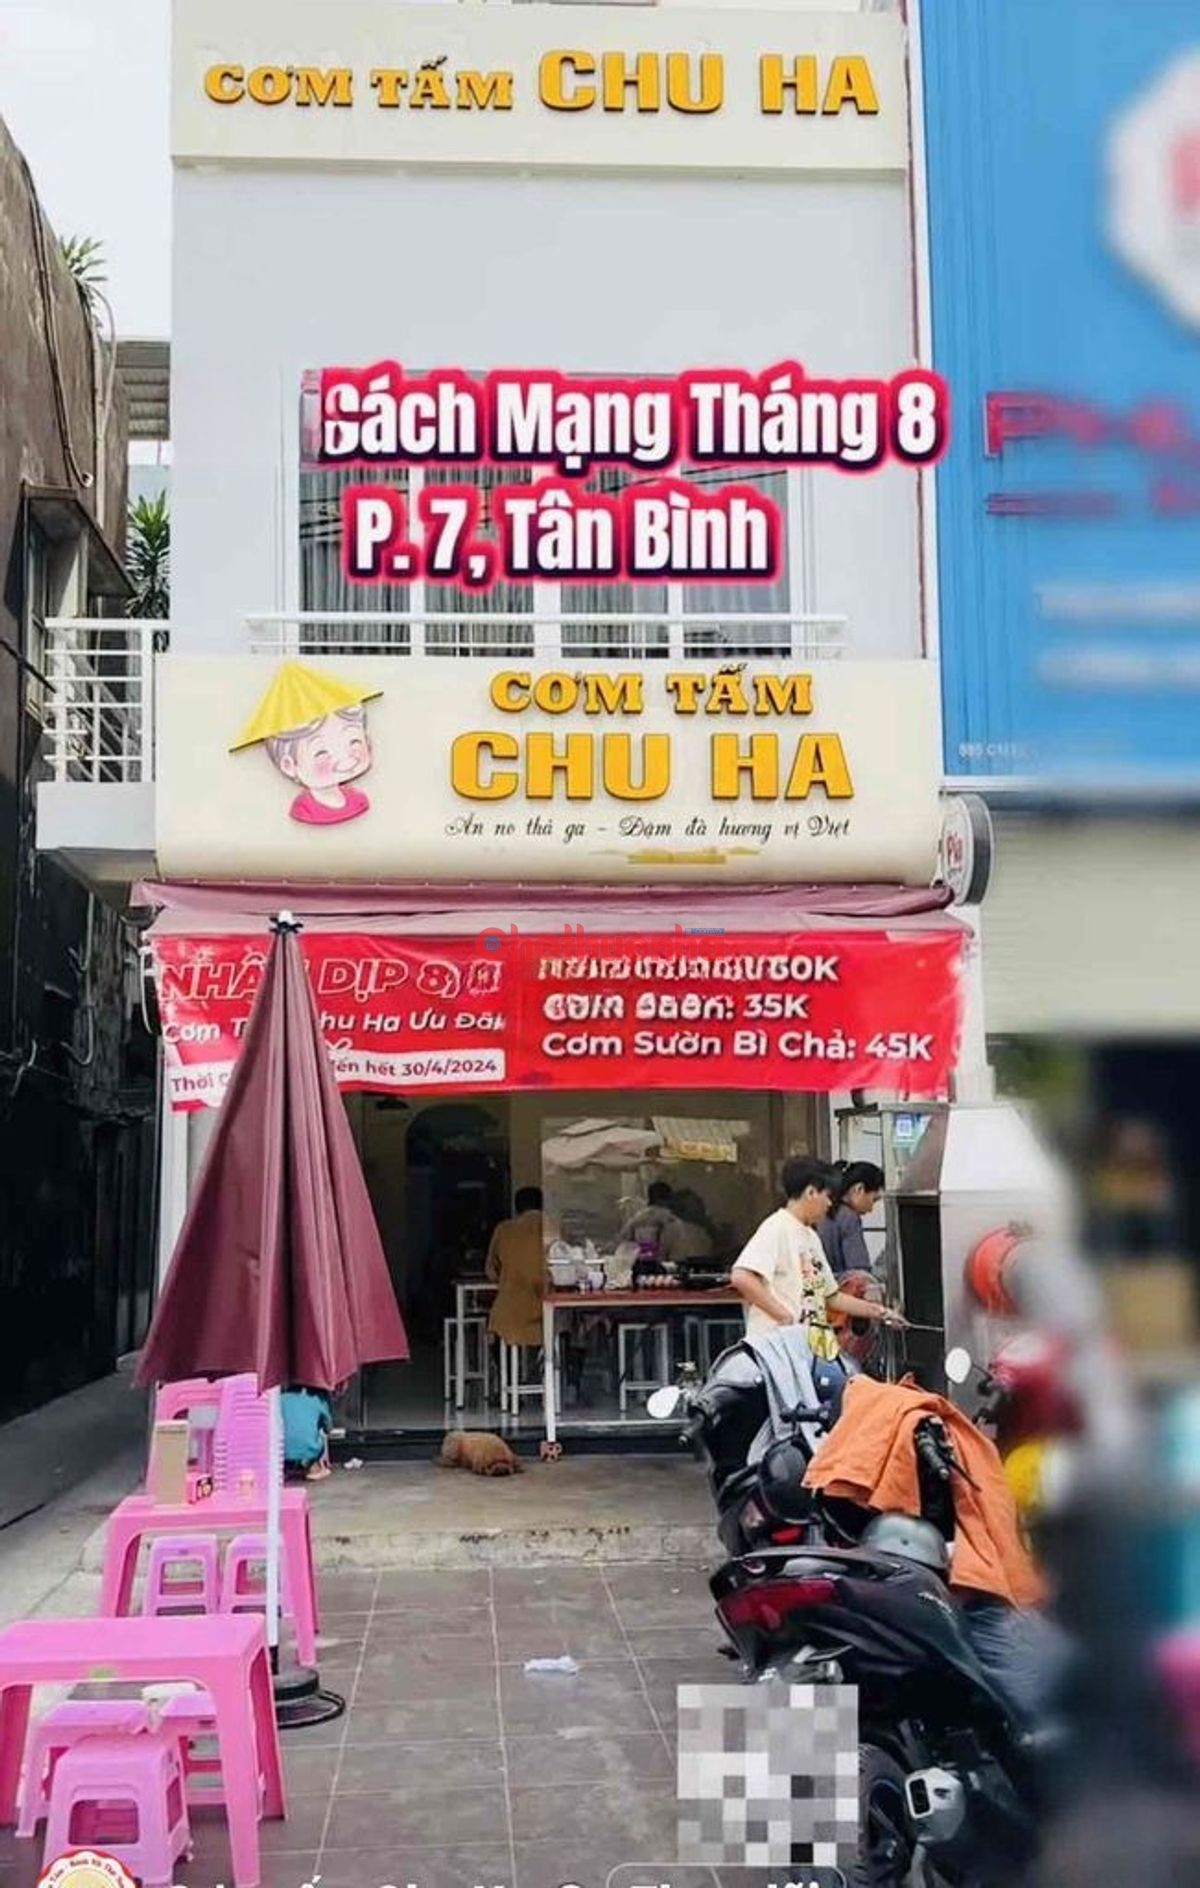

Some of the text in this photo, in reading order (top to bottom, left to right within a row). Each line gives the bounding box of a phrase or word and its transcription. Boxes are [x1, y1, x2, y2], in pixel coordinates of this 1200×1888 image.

[204, 49, 880, 114] CƠM TẤM CHU HA
[489, 662, 813, 715] CƠM TẤM
[450, 730, 855, 801] CHU HA
[494, 822, 516, 836] no
[563, 822, 585, 844] ga
[317, 958, 410, 1004] DỊP
[320, 1010, 355, 1030] hu
[409, 1007, 447, 1031] Ưu
[743, 993, 809, 1019] 35K
[542, 1028, 933, 1061] Cơm Sườn Bì Chả: 45K
[402, 1058, 497, 1078] 30/4/2024
